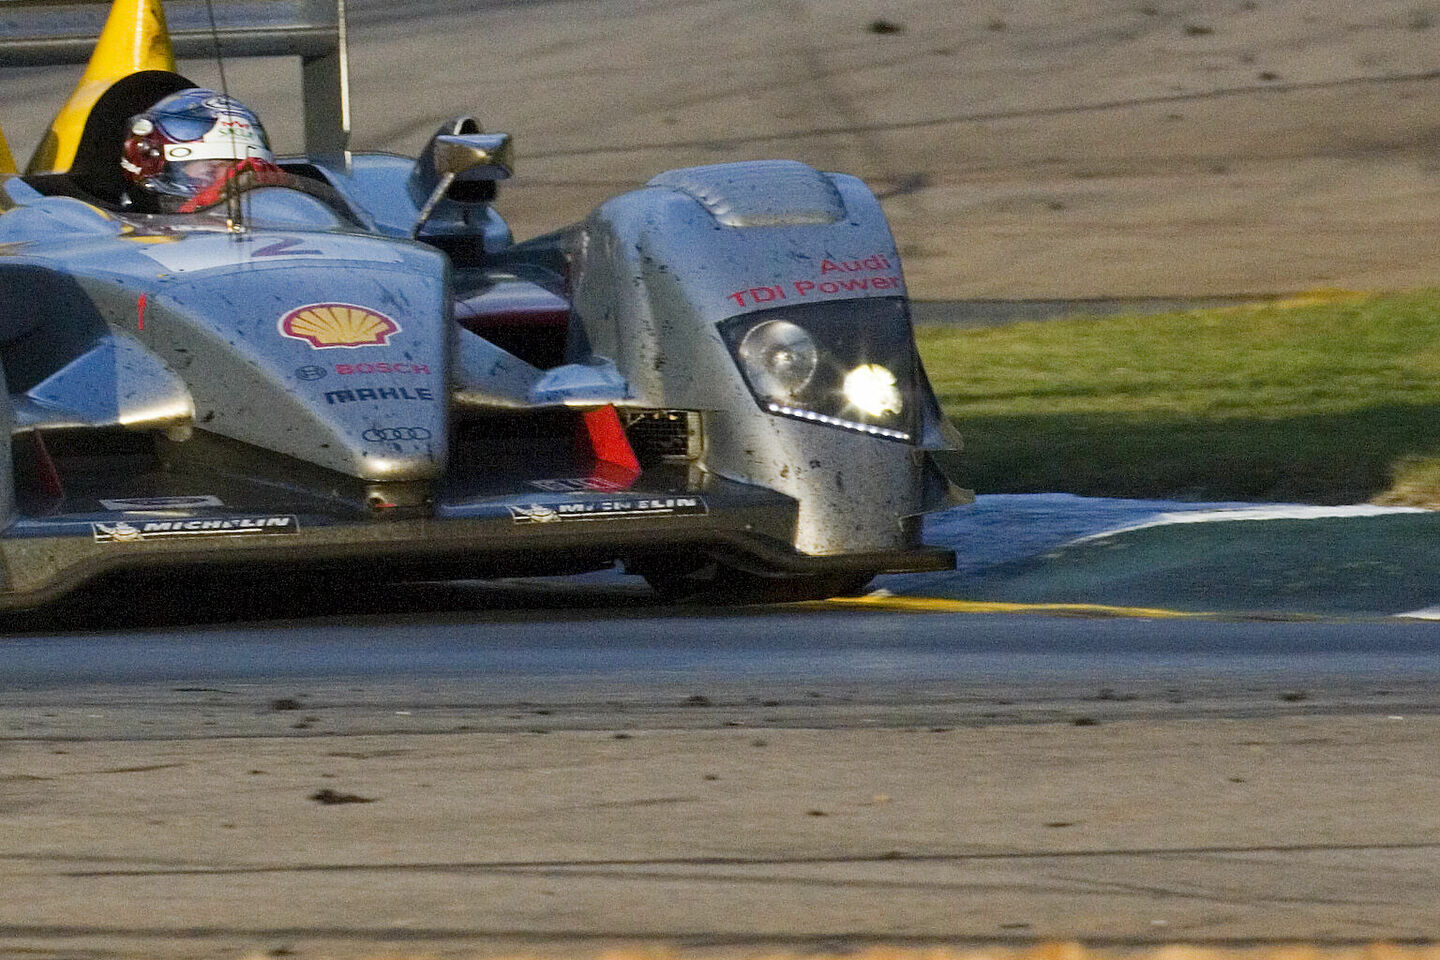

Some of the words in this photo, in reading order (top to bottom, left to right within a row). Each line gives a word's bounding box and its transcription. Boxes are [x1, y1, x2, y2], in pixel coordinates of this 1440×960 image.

[821, 254, 891, 275] Audi
[727, 285, 787, 307] TDI
[794, 276, 900, 297] Power
[336, 362, 431, 375] BOSCH
[324, 388, 435, 405] MAHLE
[559, 498, 697, 513] MICHELIN
[143, 517, 290, 531] MICHELIN
